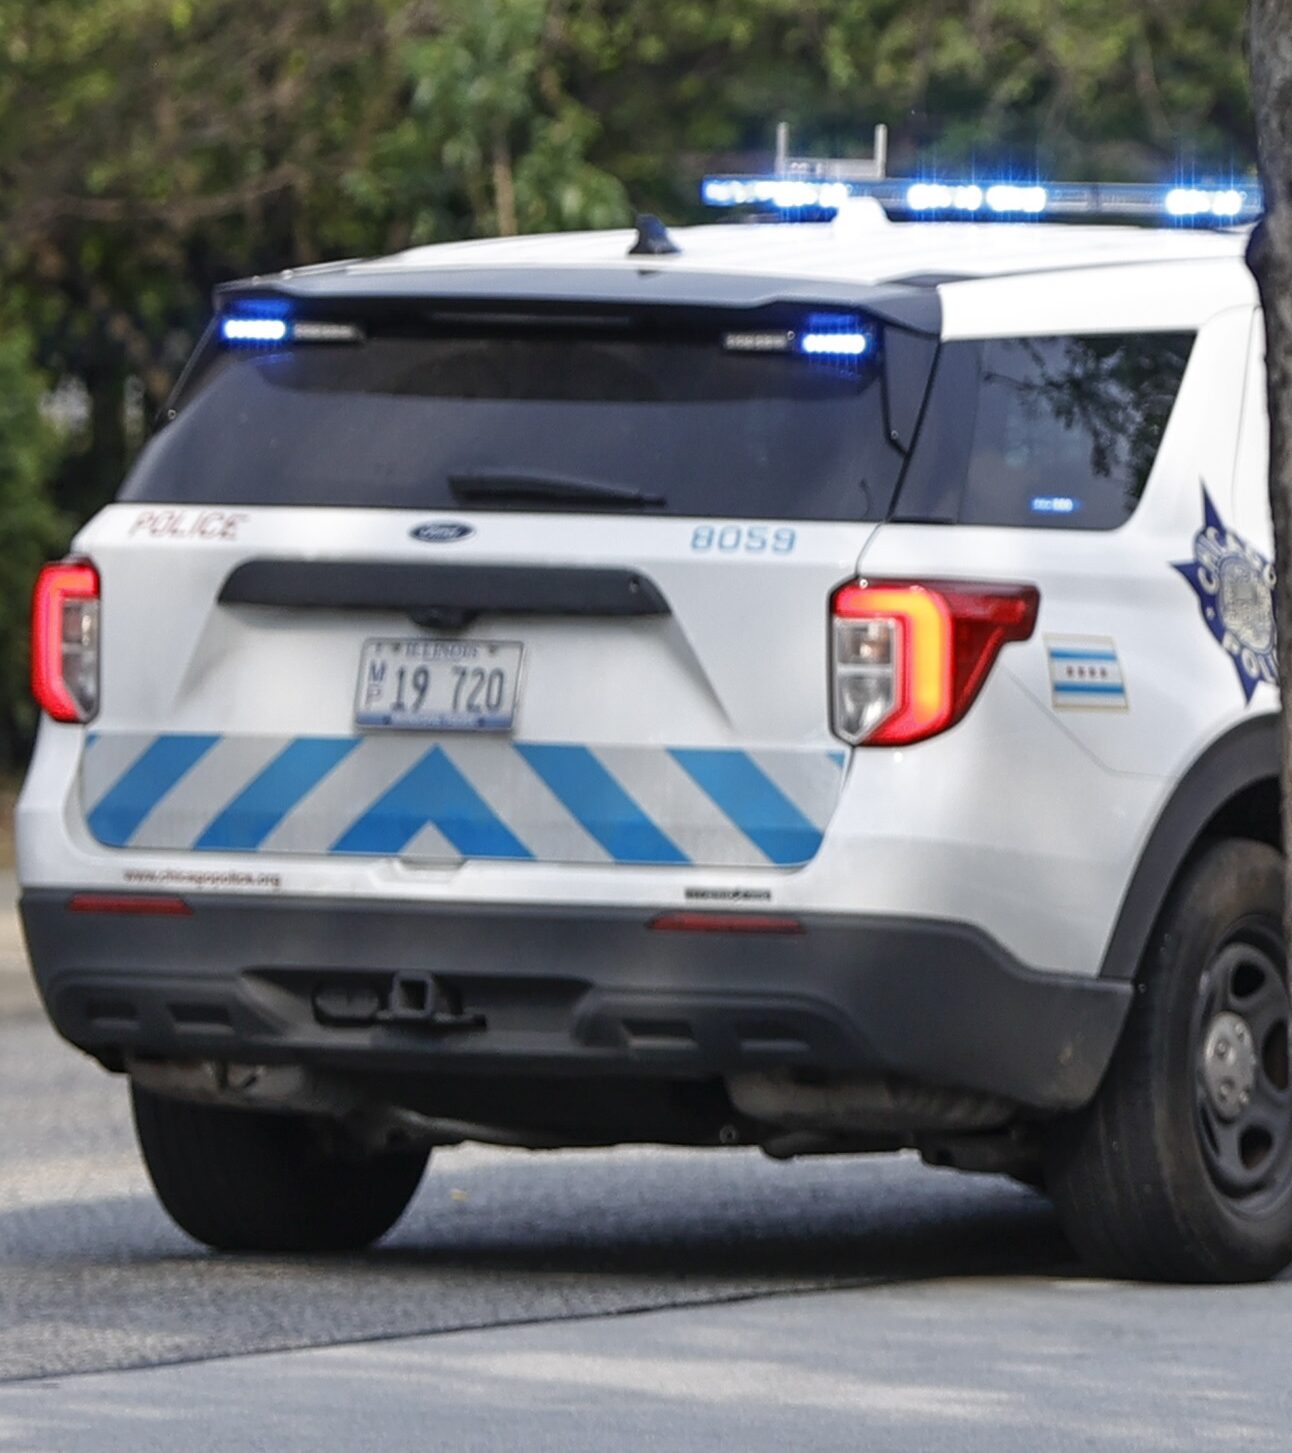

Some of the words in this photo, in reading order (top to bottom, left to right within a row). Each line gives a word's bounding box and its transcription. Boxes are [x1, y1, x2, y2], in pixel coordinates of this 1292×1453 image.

[127, 510, 249, 540] POLICE
[690, 525, 796, 555] 8059
[391, 665, 430, 713] 19
[452, 665, 504, 713] 720
